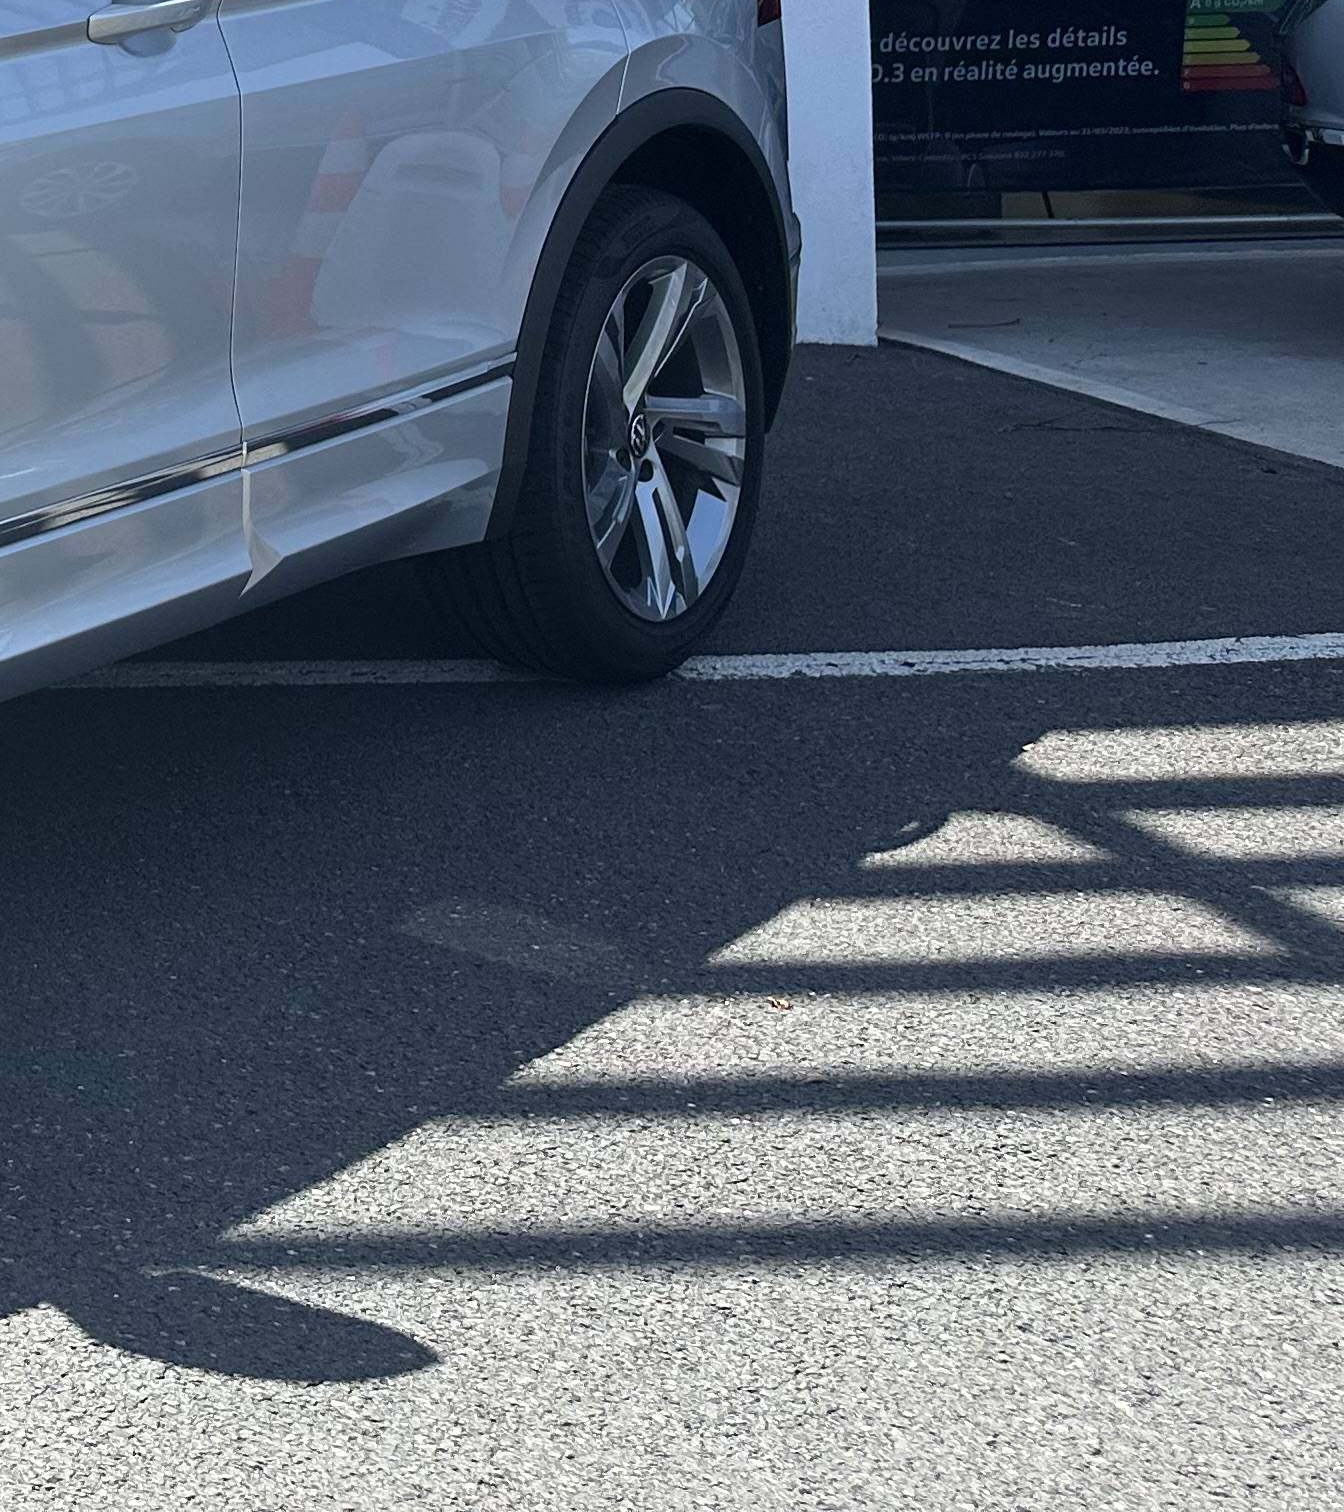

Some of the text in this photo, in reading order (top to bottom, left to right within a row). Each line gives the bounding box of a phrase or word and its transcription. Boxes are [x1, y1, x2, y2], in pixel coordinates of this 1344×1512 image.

[879, 26, 1128, 53] découvrez les détails
[871, 55, 1160, 84] D.3 en réalité augmentée.
